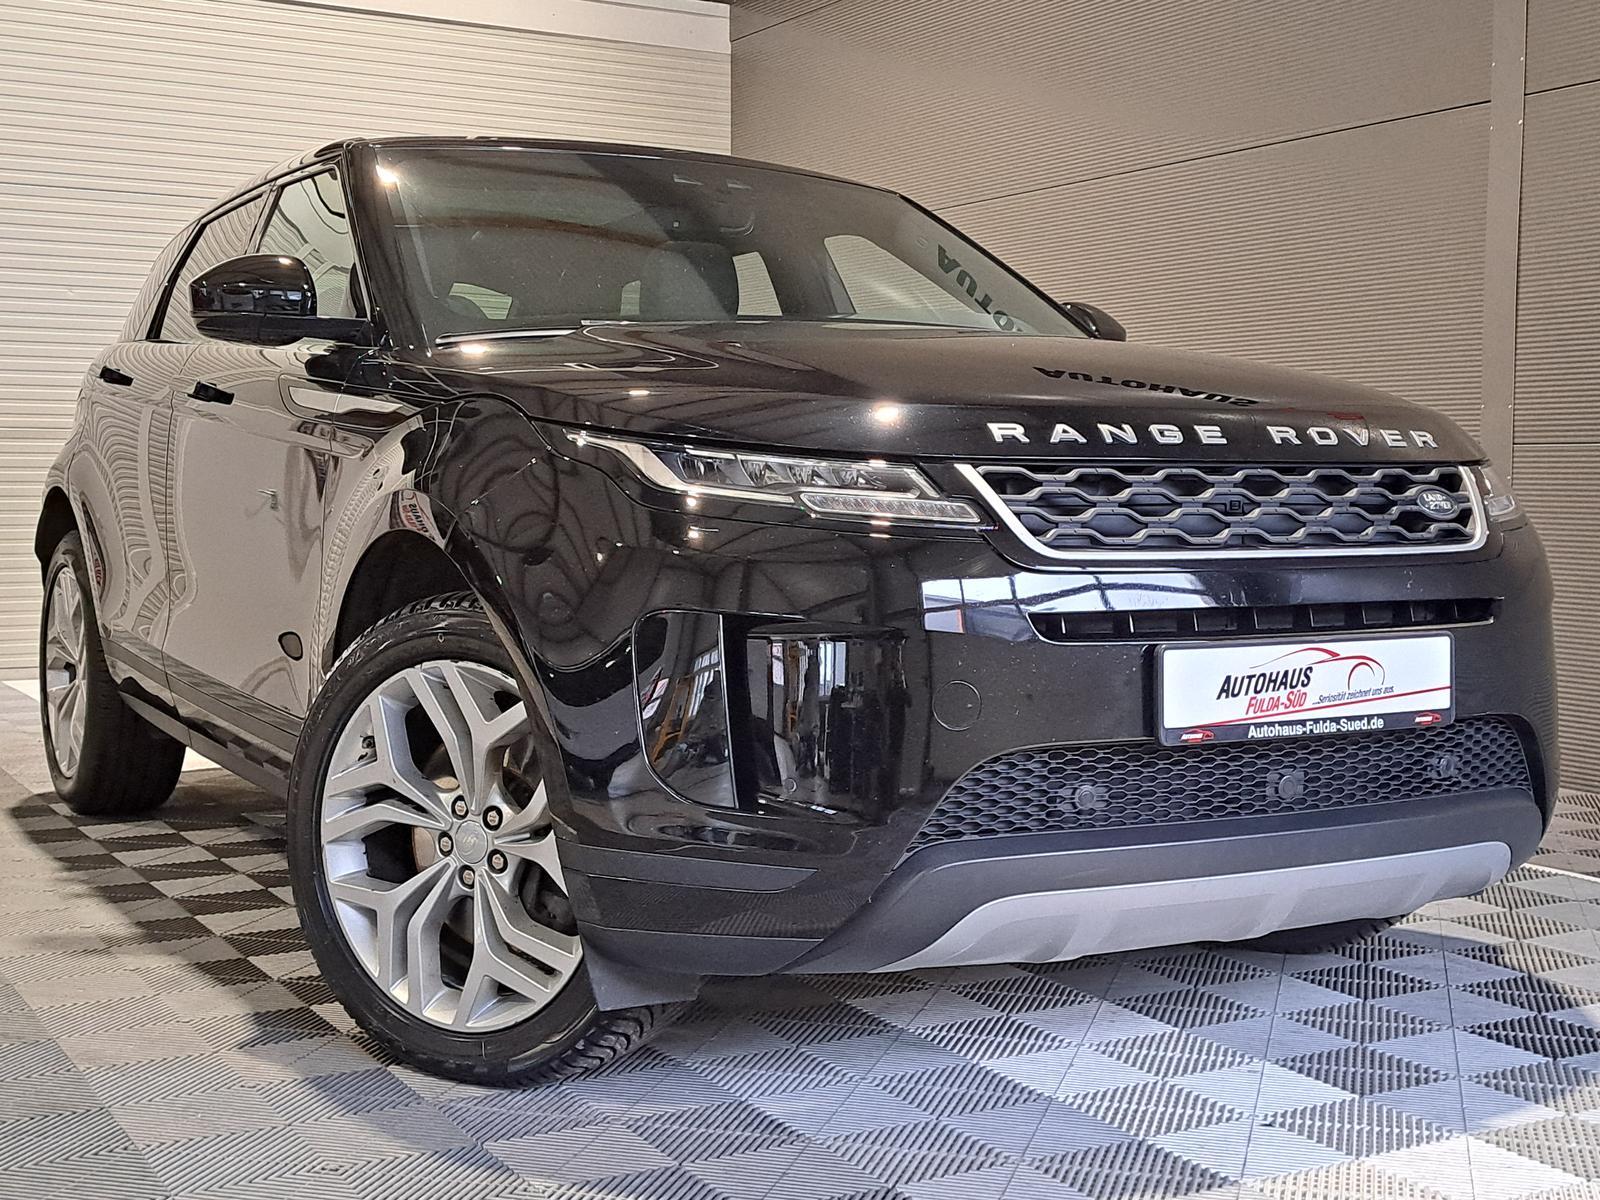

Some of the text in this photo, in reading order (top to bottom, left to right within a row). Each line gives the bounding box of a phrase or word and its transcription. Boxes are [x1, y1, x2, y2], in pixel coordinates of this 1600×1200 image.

[986, 421, 1439, 449] RANGE ROVER
[1215, 666, 1314, 701] AUTOHAUS
[1245, 690, 1308, 716] FULDA-SÜD
[1247, 716, 1385, 740] Autohaus-Fulda-Sued.de
